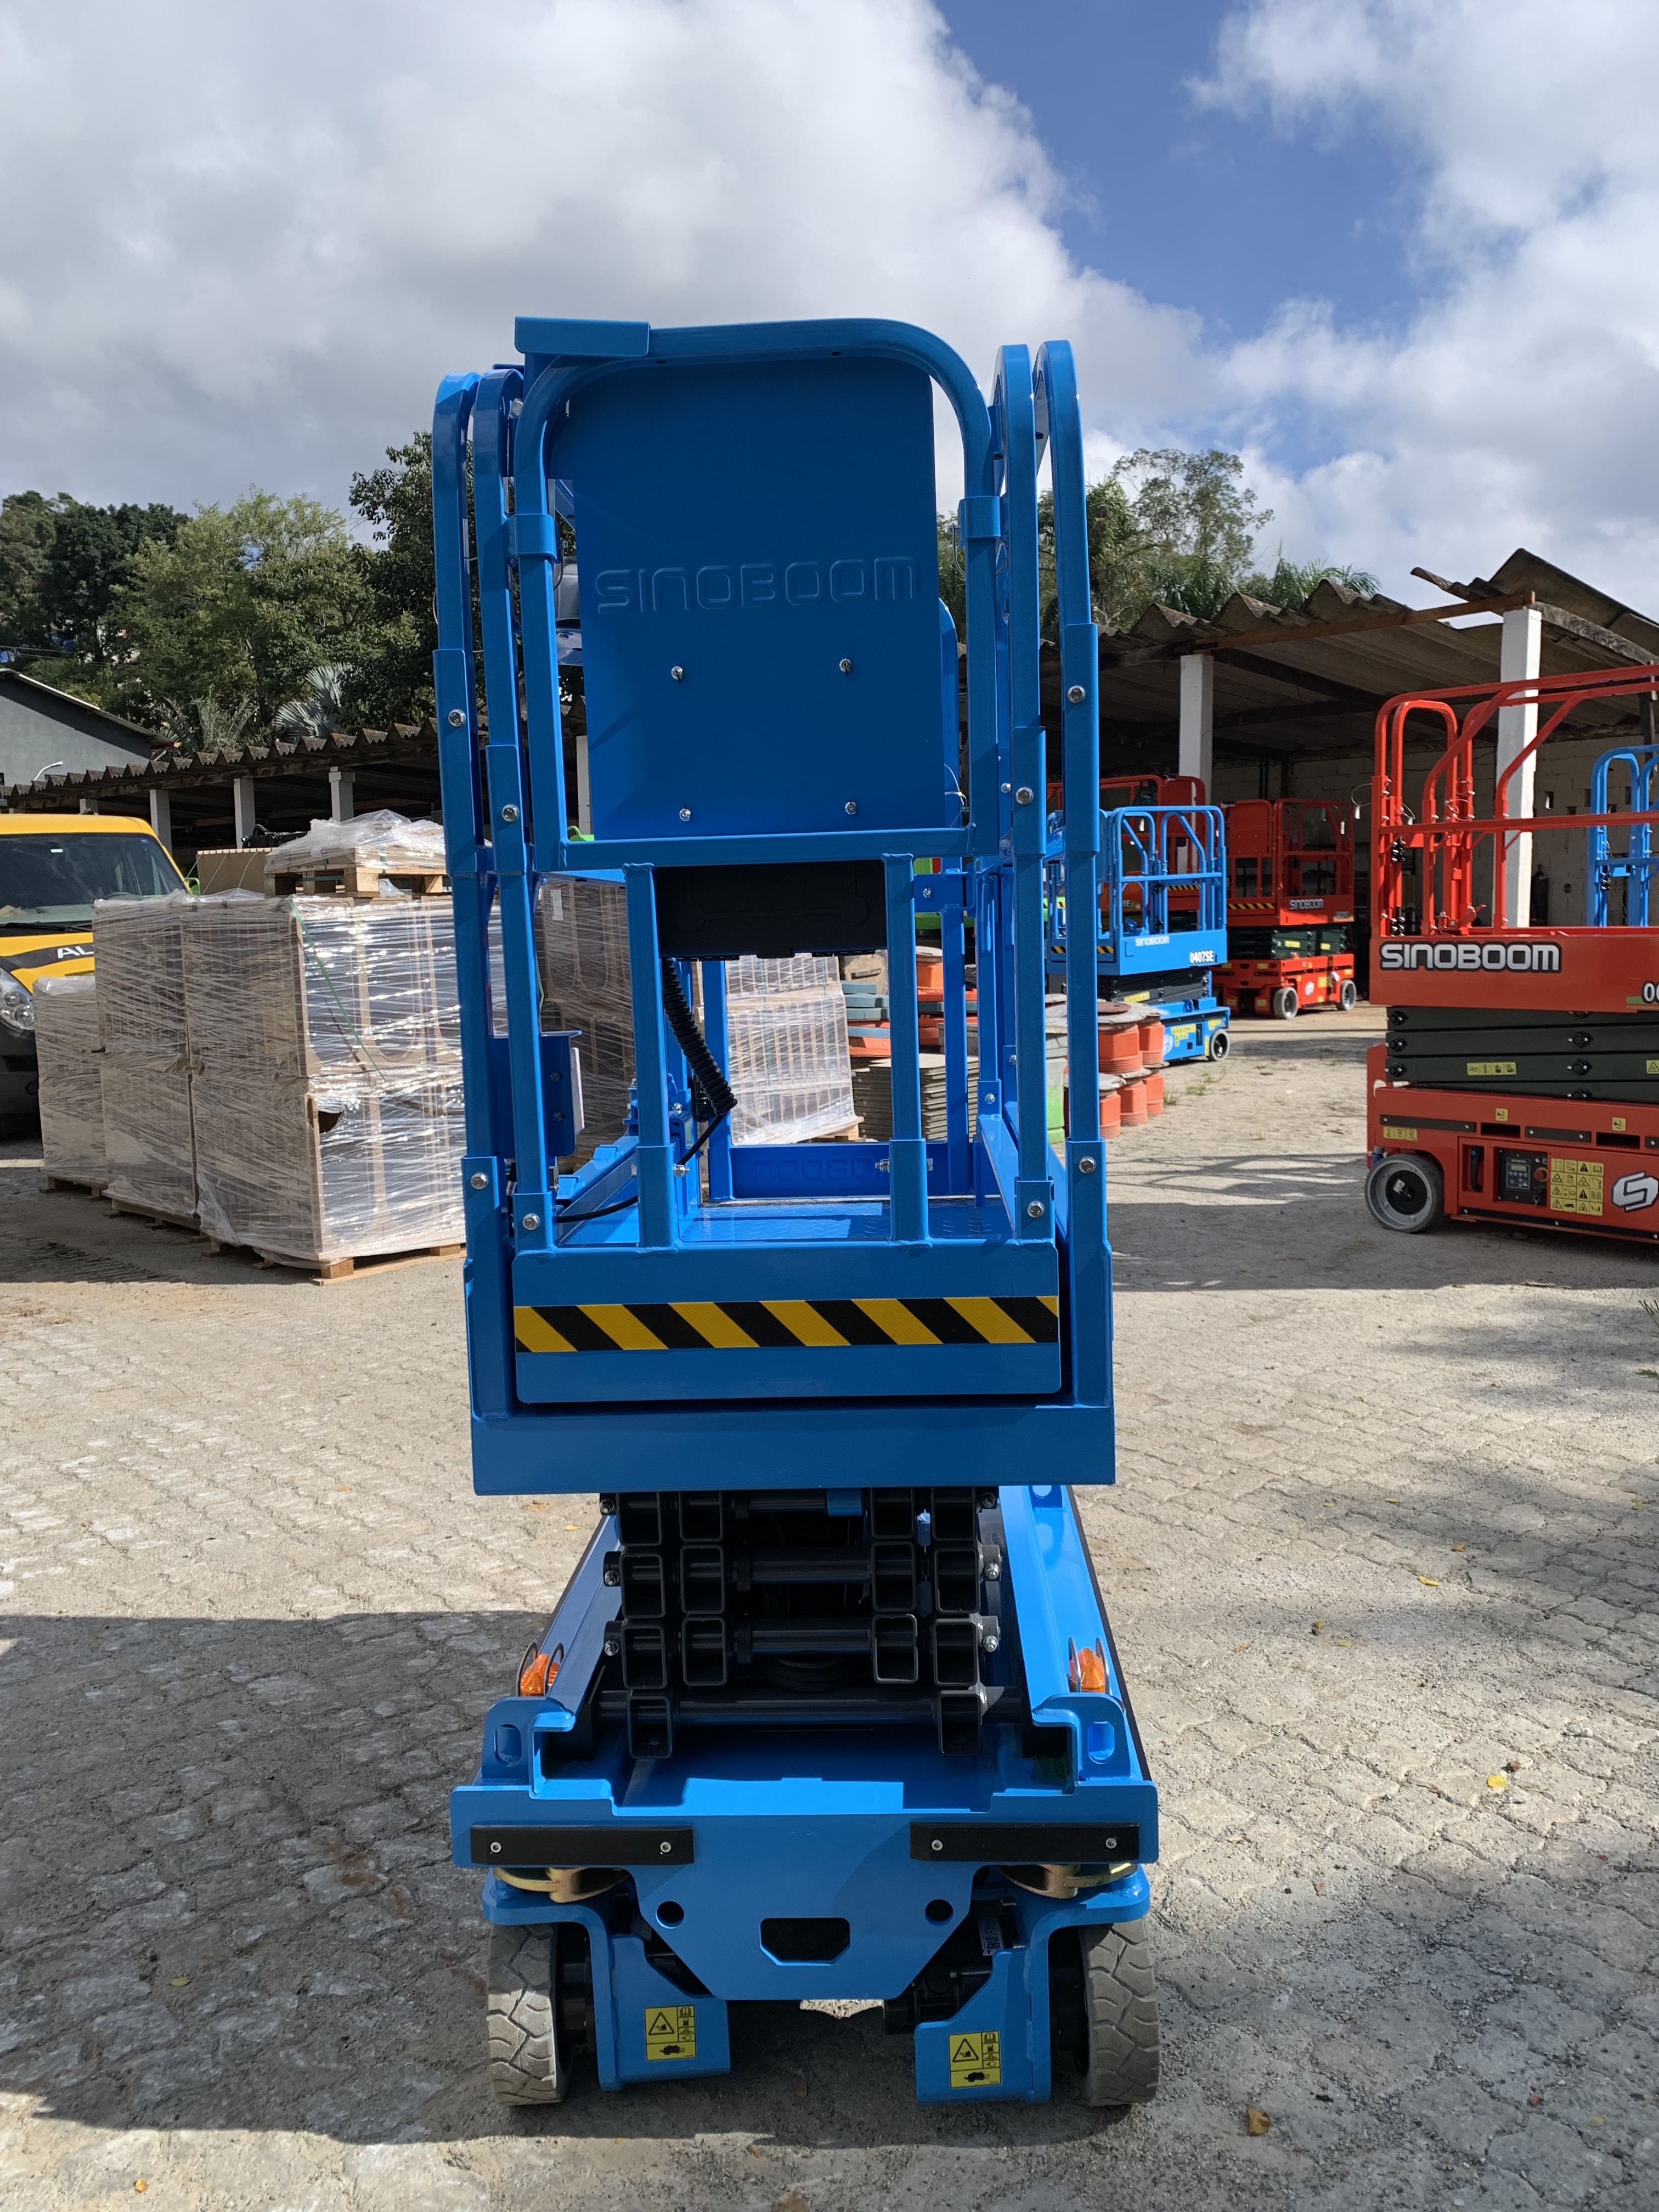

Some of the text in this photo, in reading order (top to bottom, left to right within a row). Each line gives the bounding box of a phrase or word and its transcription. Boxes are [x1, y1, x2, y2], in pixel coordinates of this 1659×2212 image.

[594, 556, 921, 614] SINOBOOM
[1289, 898, 1324, 910] SINOBOOM
[1135, 935, 1170, 947] SINOBOOM
[57, 945, 94, 959] AL
[1189, 950, 1214, 964] 0407SE
[1380, 943, 1560, 972] SINOBOOM
[1643, 981, 1659, 1003] 0
